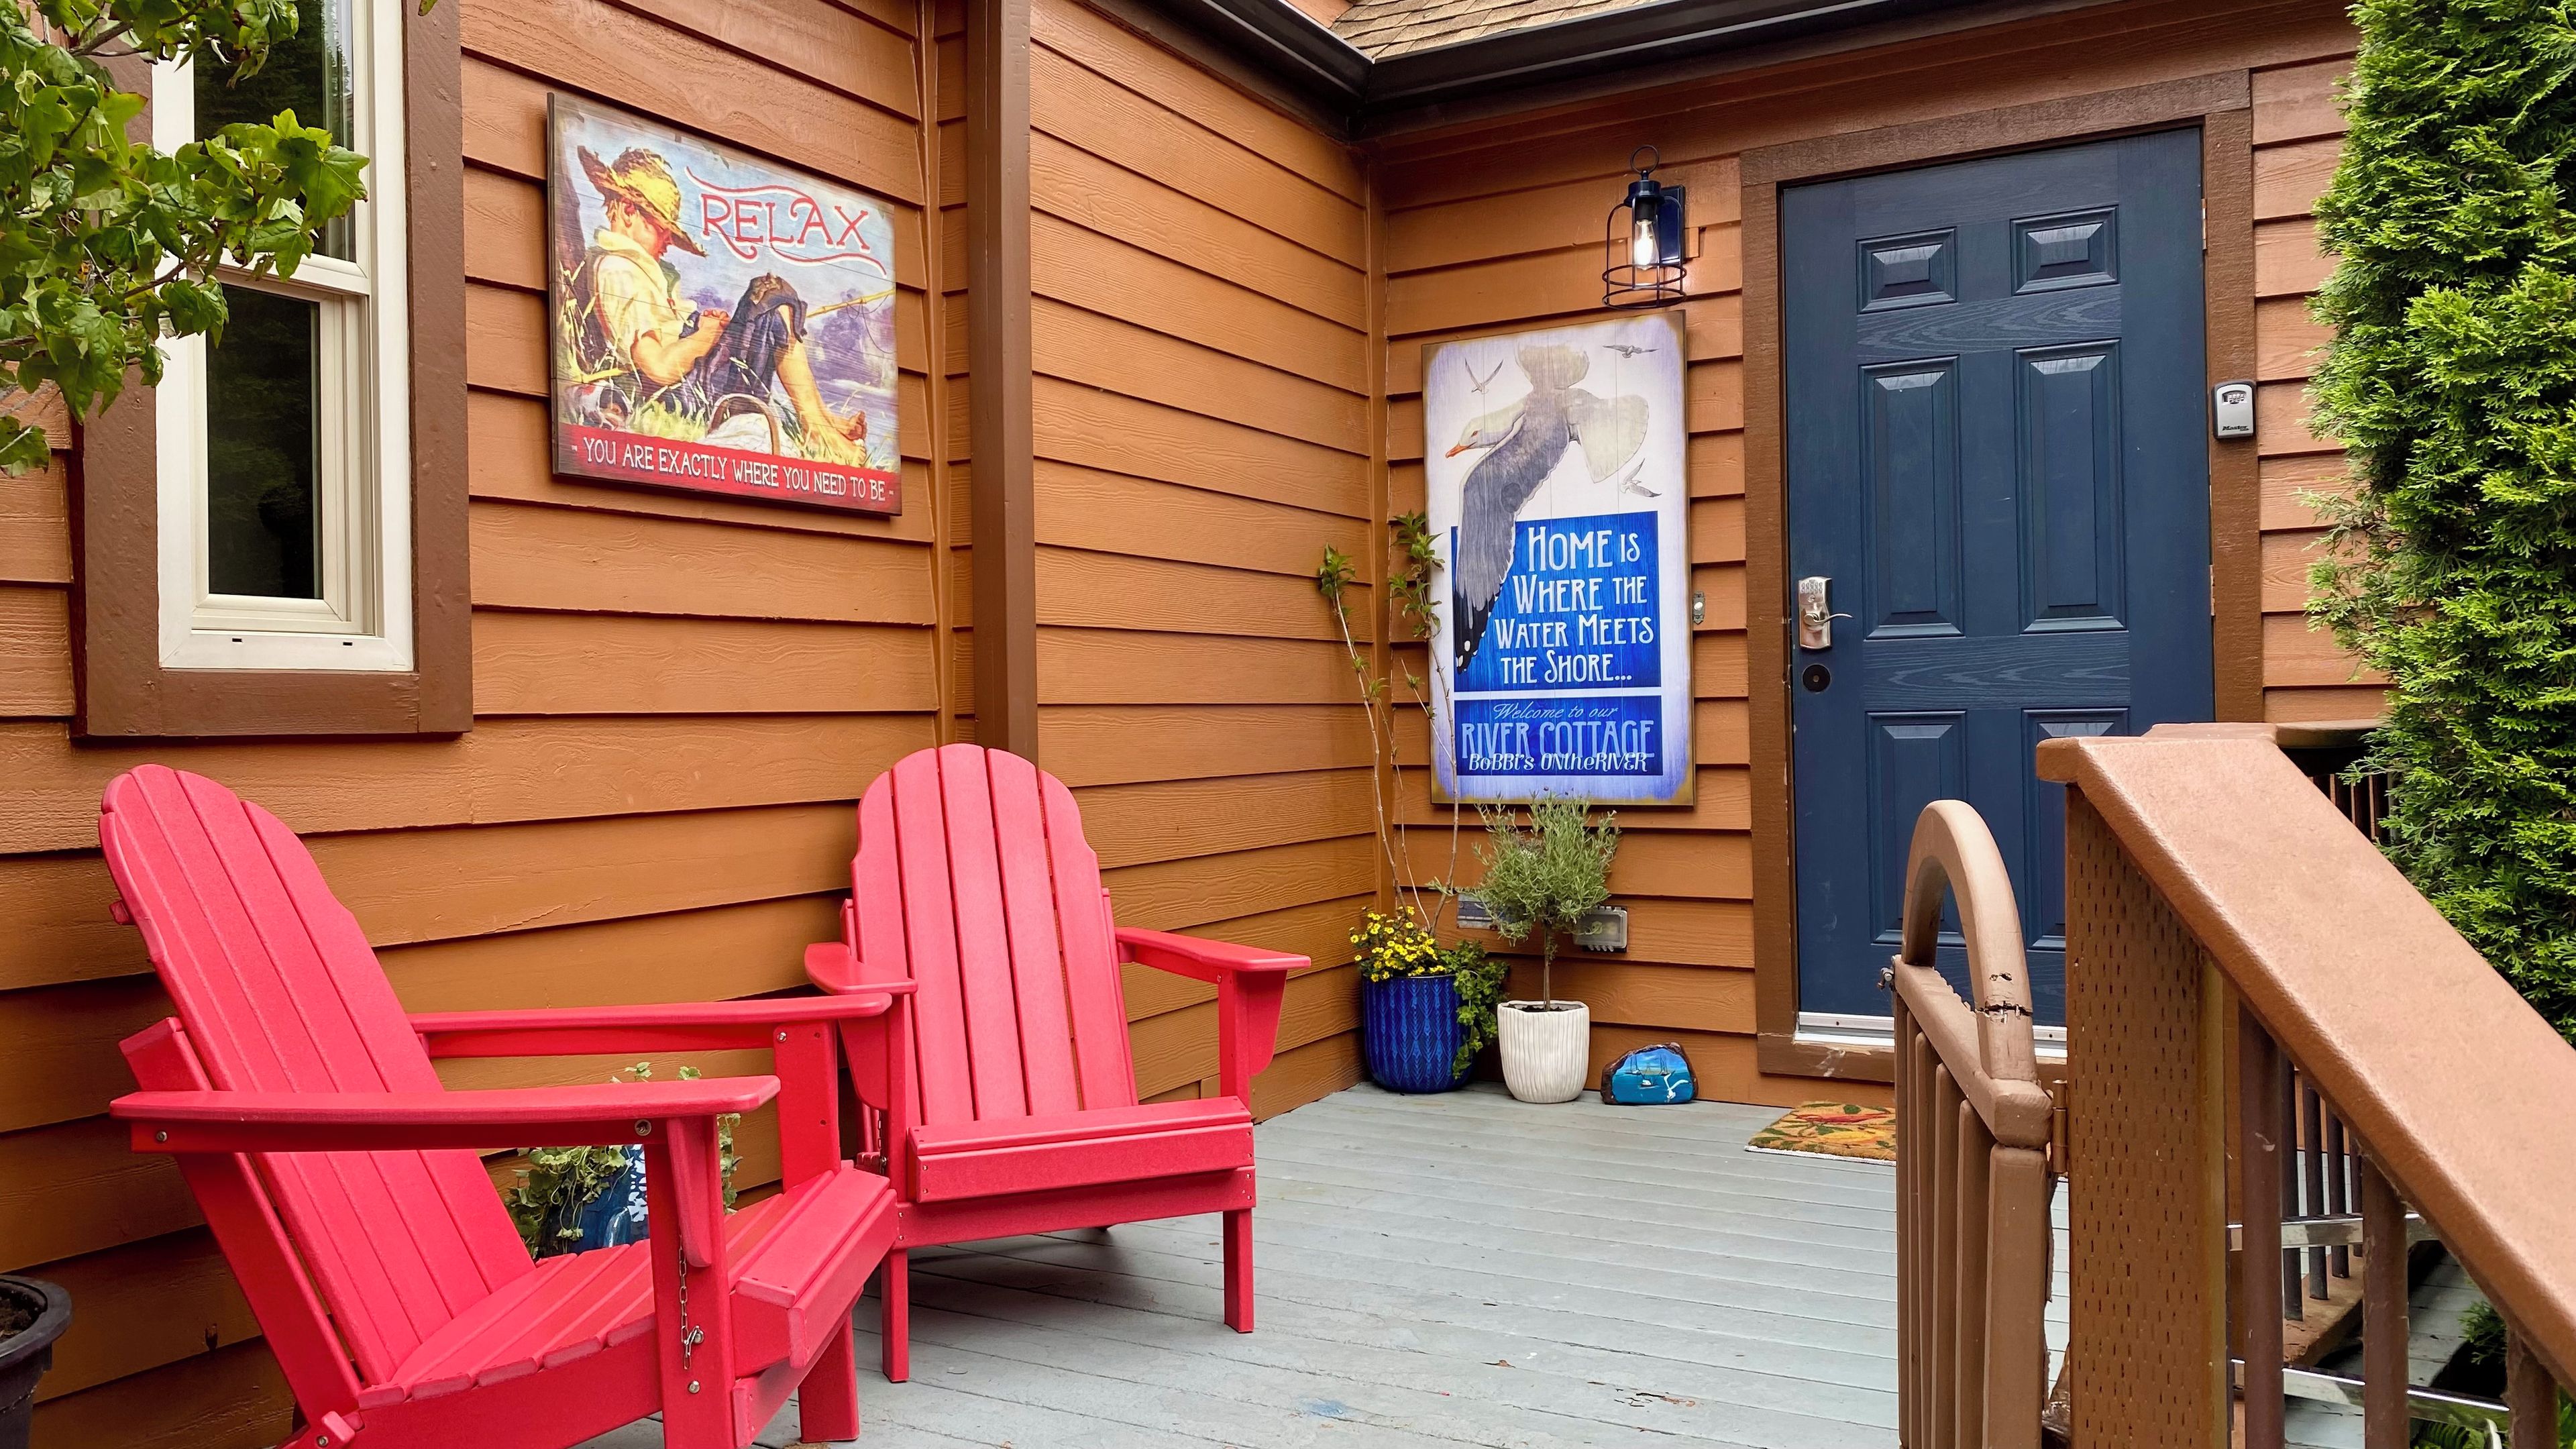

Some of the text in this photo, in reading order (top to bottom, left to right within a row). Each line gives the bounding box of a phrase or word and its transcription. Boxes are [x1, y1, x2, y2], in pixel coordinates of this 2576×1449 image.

[697, 189, 873, 264] RELAX
[583, 436, 885, 501] YOU ARE EXACTLY WHERE YOU NEED TO BE
[1527, 526, 1641, 572] HOME IS
[1512, 574, 1648, 614] WHERE THE
[1494, 614, 1654, 649] WATER MEETS
[1500, 657, 1538, 684] THE
[1493, 701, 1619, 720] Welcome to our
[1461, 720, 1656, 759] RIVER COTTAGE
